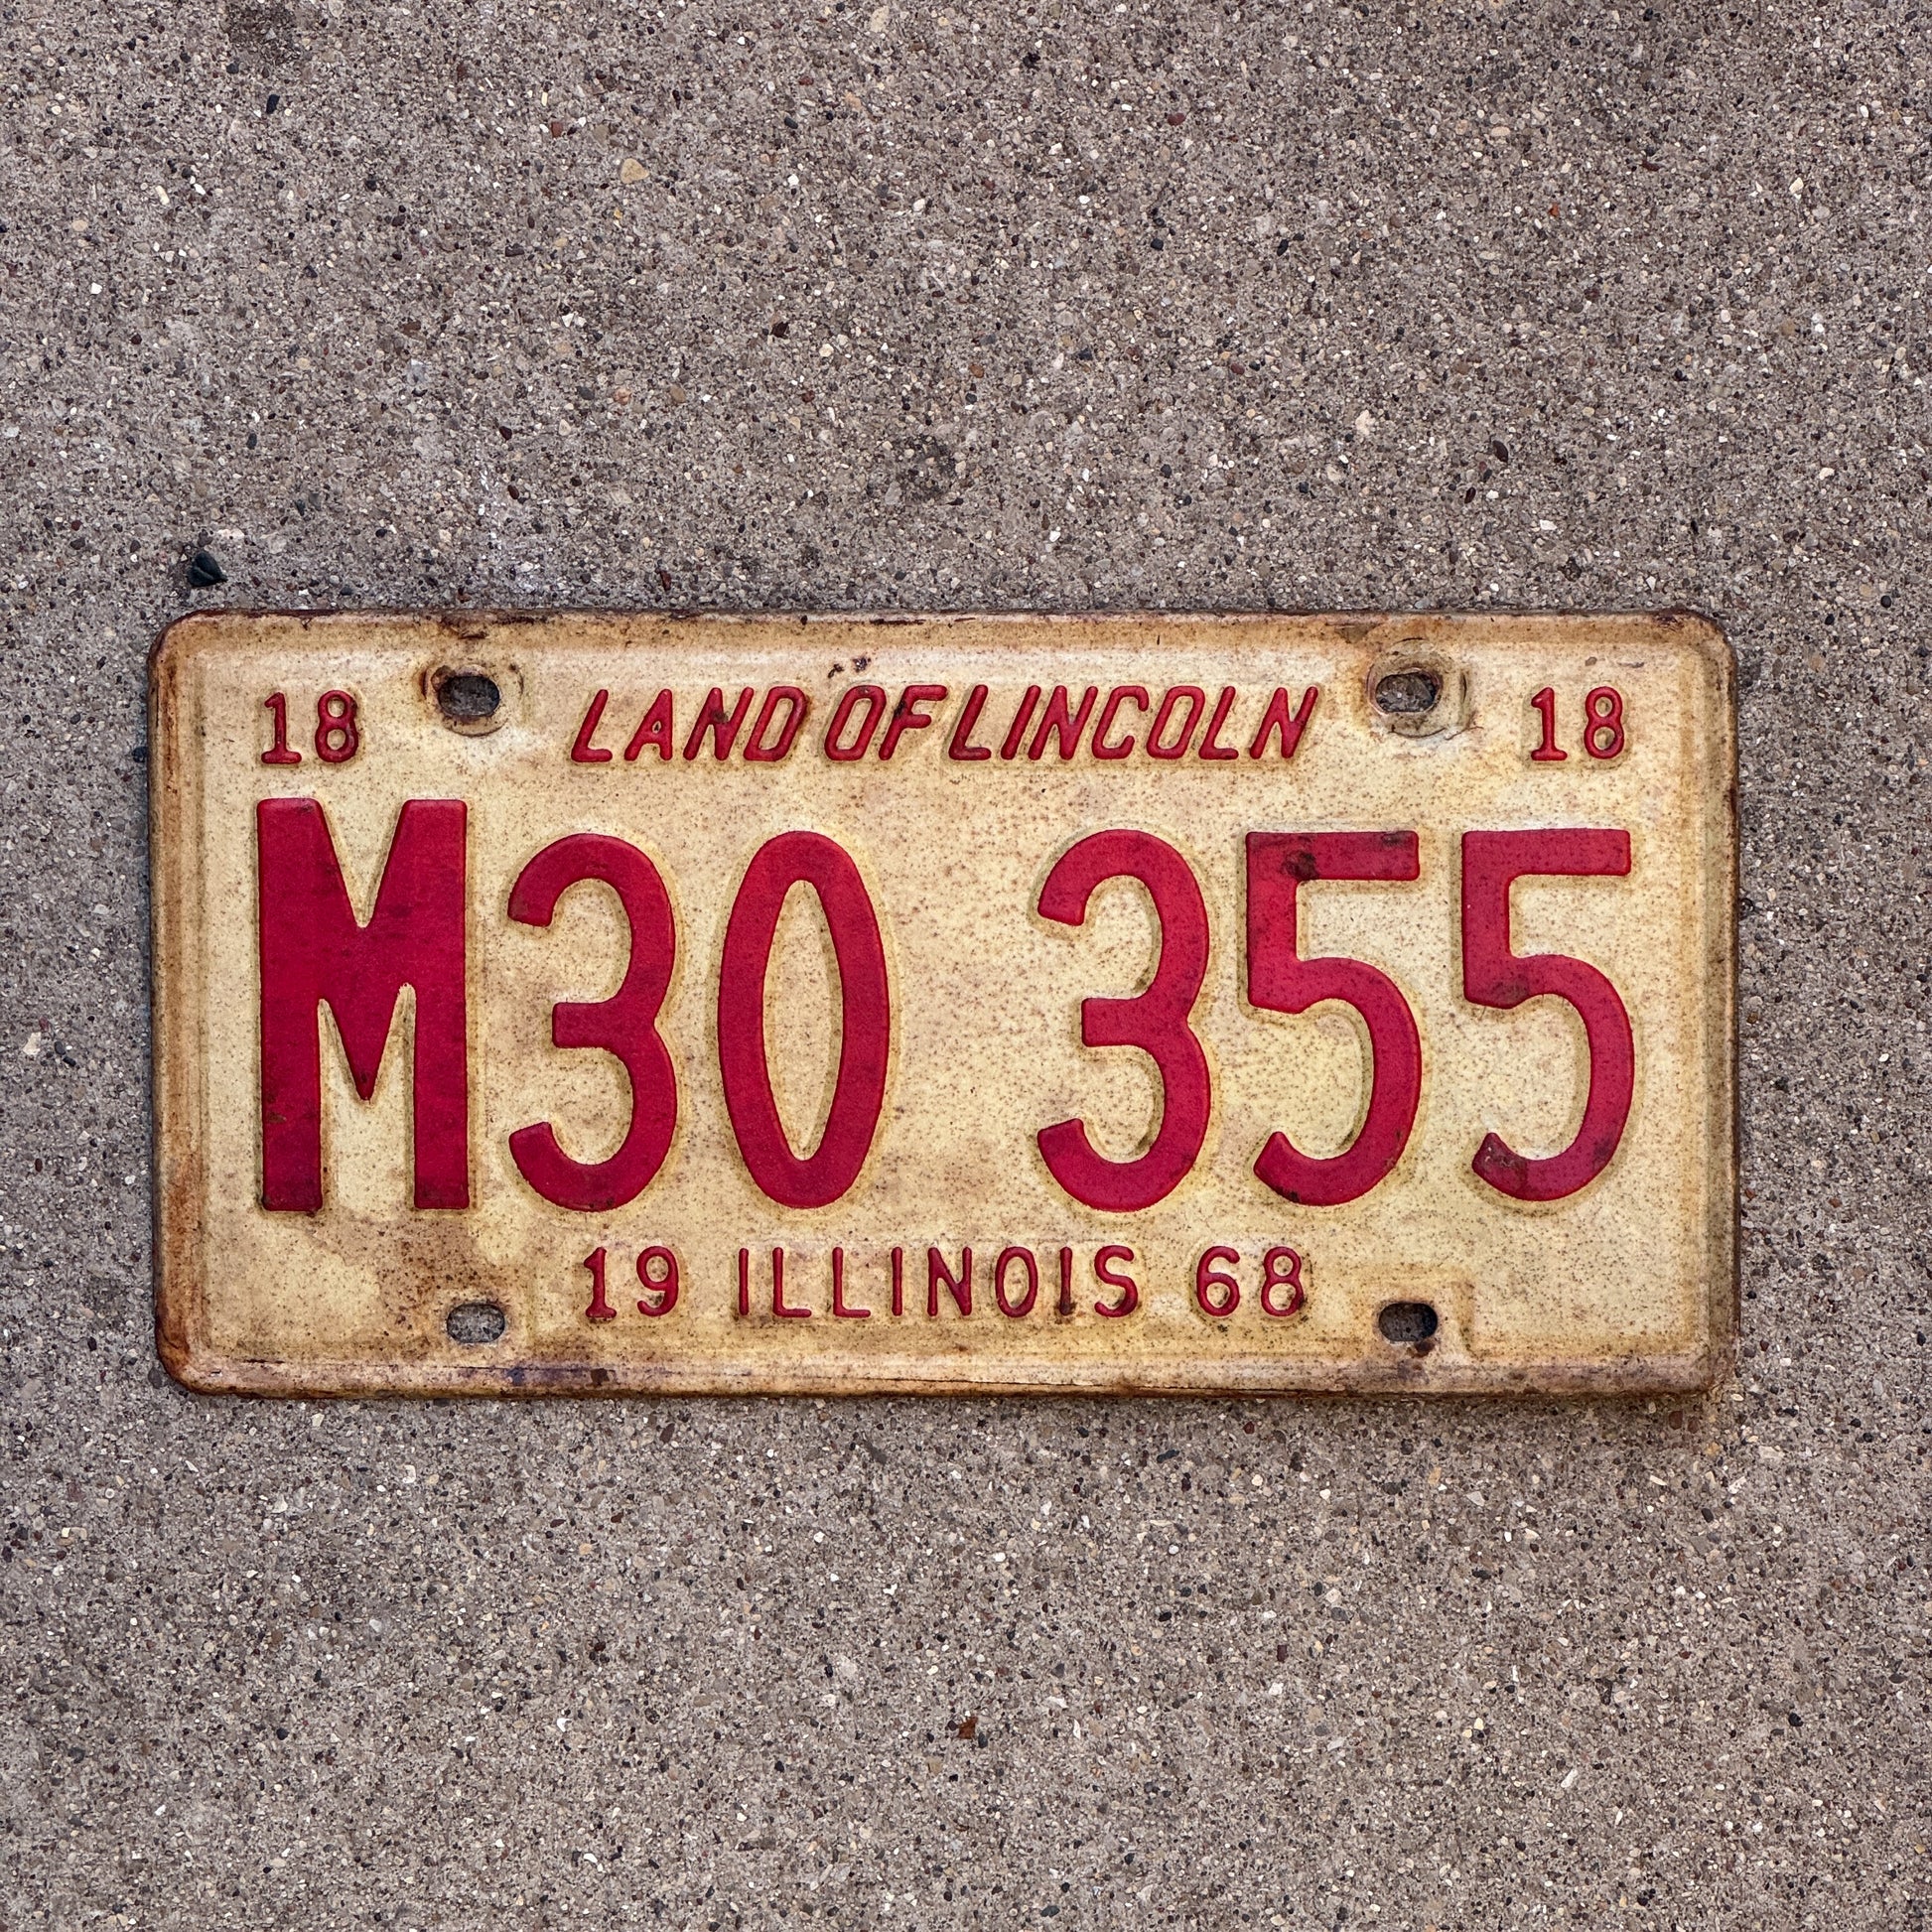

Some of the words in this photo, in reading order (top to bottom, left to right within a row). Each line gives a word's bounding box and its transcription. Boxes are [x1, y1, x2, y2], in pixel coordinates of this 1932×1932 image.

[260, 689, 360, 765] 18
[570, 685, 809, 763] LAND
[823, 684, 949, 761] OF
[949, 685, 1320, 761] LINCOLN
[1530, 685, 1625, 761] 18
[255, 797, 892, 1214] M30
[1035, 827, 1636, 1213] 355
[582, 1245, 681, 1321] 19
[738, 1244, 1139, 1319] ILLINOIS
[1195, 1245, 1307, 1318] 68
